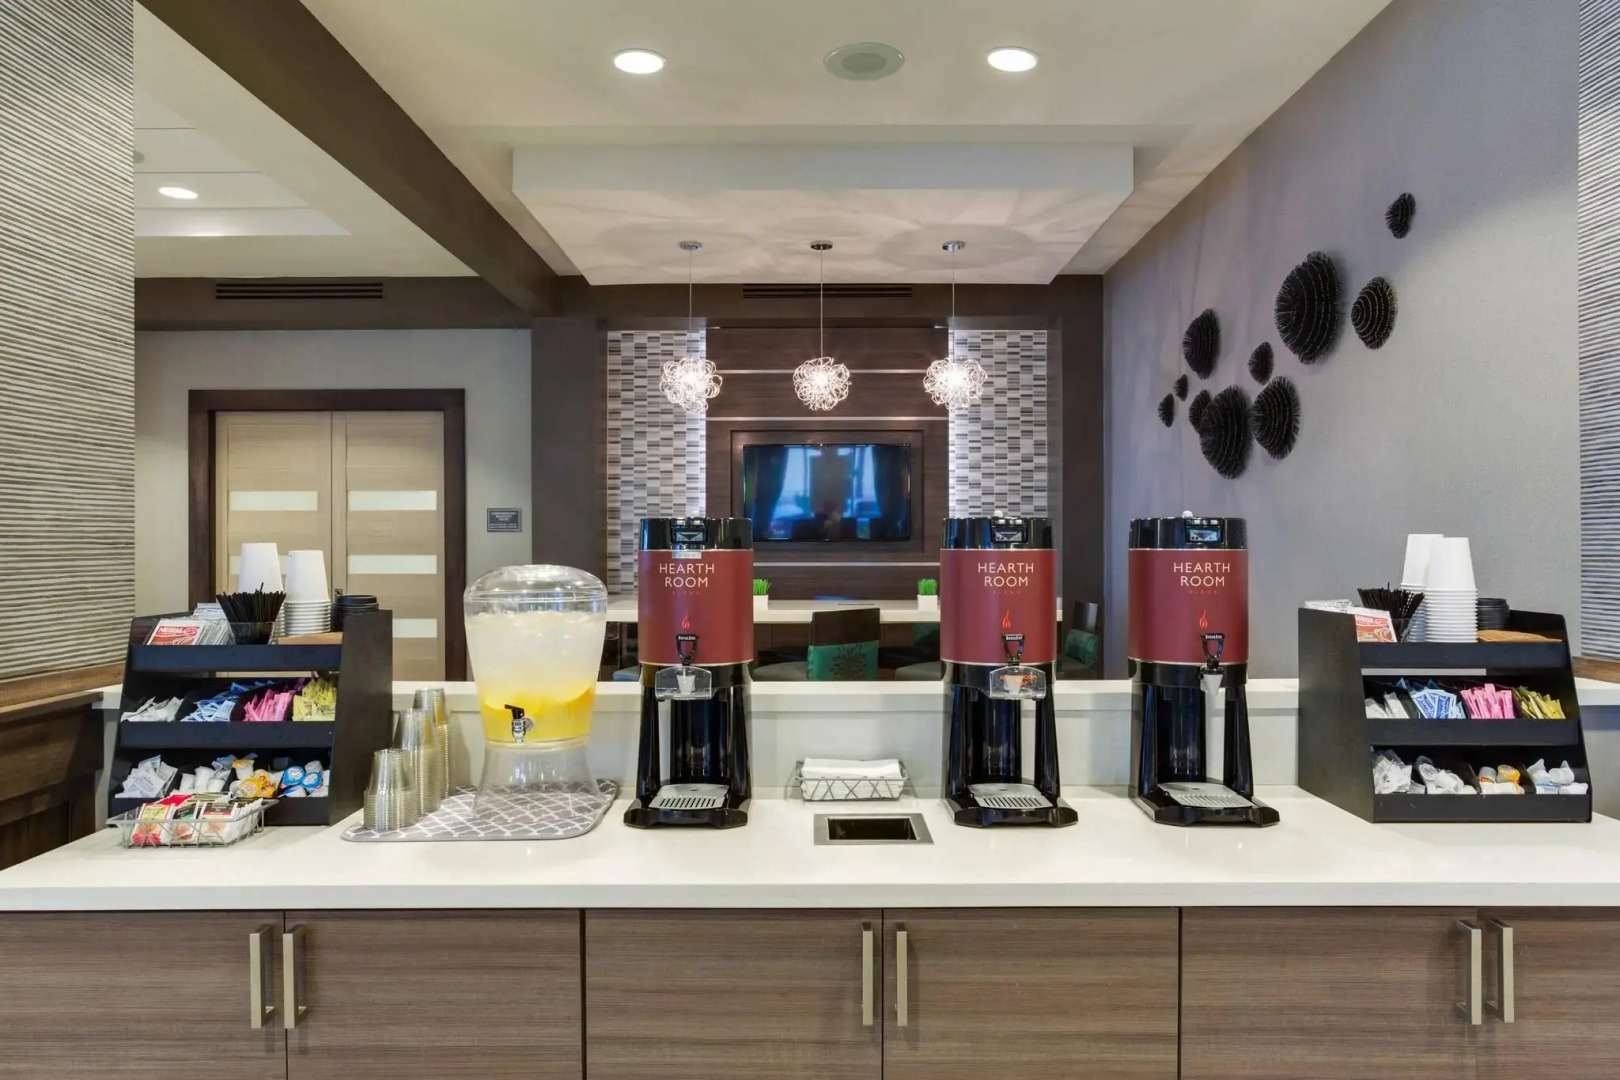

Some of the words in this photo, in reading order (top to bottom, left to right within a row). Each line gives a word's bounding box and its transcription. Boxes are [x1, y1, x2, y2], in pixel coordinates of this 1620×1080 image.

[659, 563, 715, 574] HEARTH
[977, 562, 1034, 574] HEARTH
[1173, 562, 1231, 573] HEARTH
[665, 576, 708, 588] ROOM
[984, 576, 1029, 587] ROOM
[1180, 575, 1225, 587] ROOM
